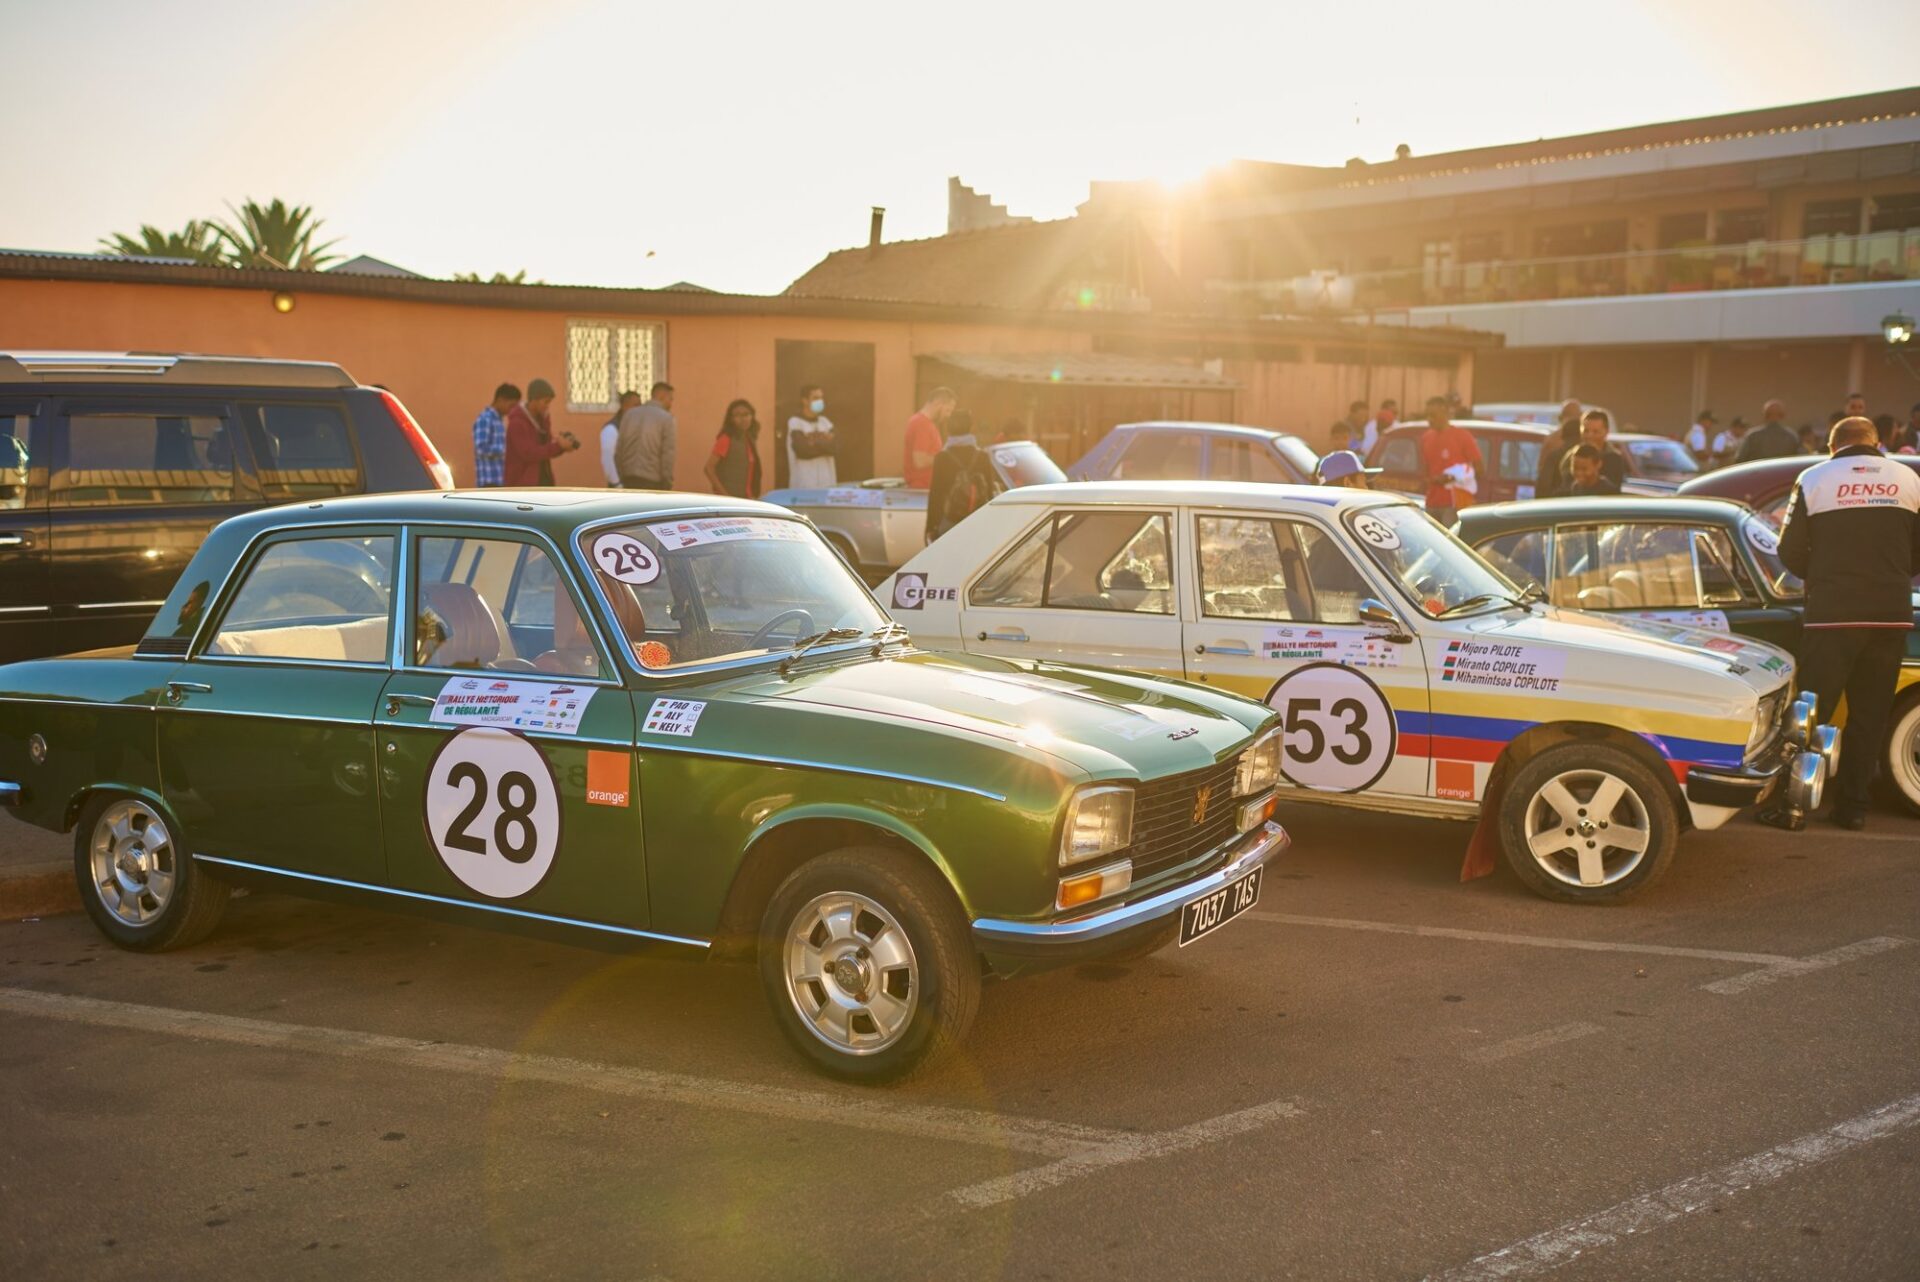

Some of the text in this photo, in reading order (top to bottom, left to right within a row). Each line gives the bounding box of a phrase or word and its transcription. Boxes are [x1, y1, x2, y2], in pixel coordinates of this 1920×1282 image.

[1837, 483, 1899, 498] DENSO
[1361, 521, 1393, 543] 53
[601, 543, 652, 576] 28
[1271, 641, 1297, 649] RALLYE
[1460, 642, 1523, 658] Mijoro PILOTE
[1456, 658, 1537, 675] Miranto COPILOTE
[1455, 671, 1559, 691] Mihamintsoa COPILOTE
[447, 695, 476, 704] RALLYE
[476, 695, 520, 704] HISTORIQUE
[443, 703, 501, 715] DE RÉGULARITÉ
[664, 711, 684, 720] ALY
[658, 722, 682, 732] KELY
[1284, 697, 1372, 766] 53
[588, 790, 625, 804] orange
[1437, 788, 1471, 799] orange
[443, 761, 538, 864] 28
[1190, 873, 1256, 936] 7037 TAS
